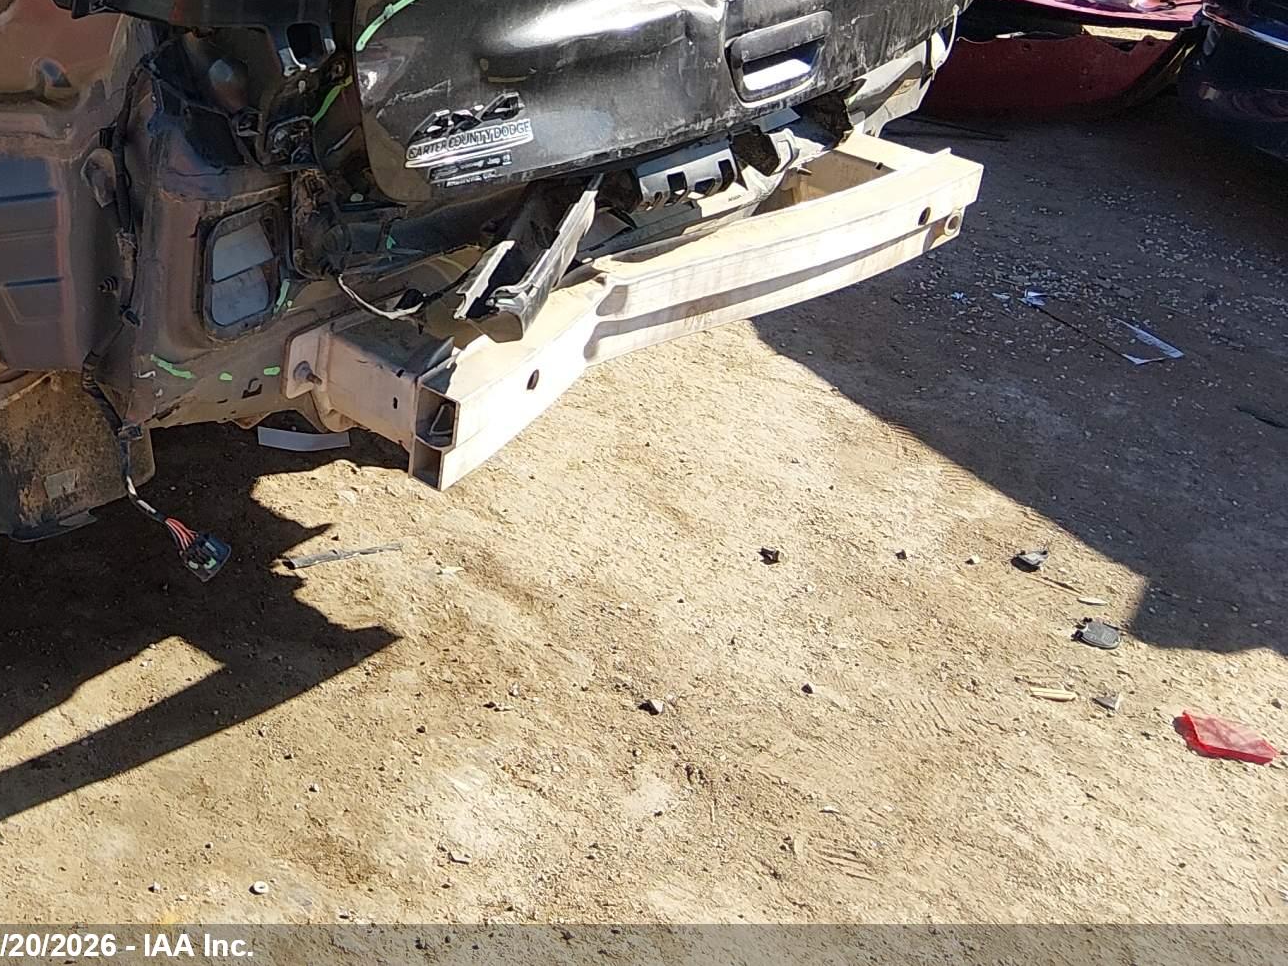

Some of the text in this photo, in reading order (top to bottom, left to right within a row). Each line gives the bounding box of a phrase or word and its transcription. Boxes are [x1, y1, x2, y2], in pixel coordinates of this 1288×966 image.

[408, 120, 531, 159] CARTER COUNTY DODGE
